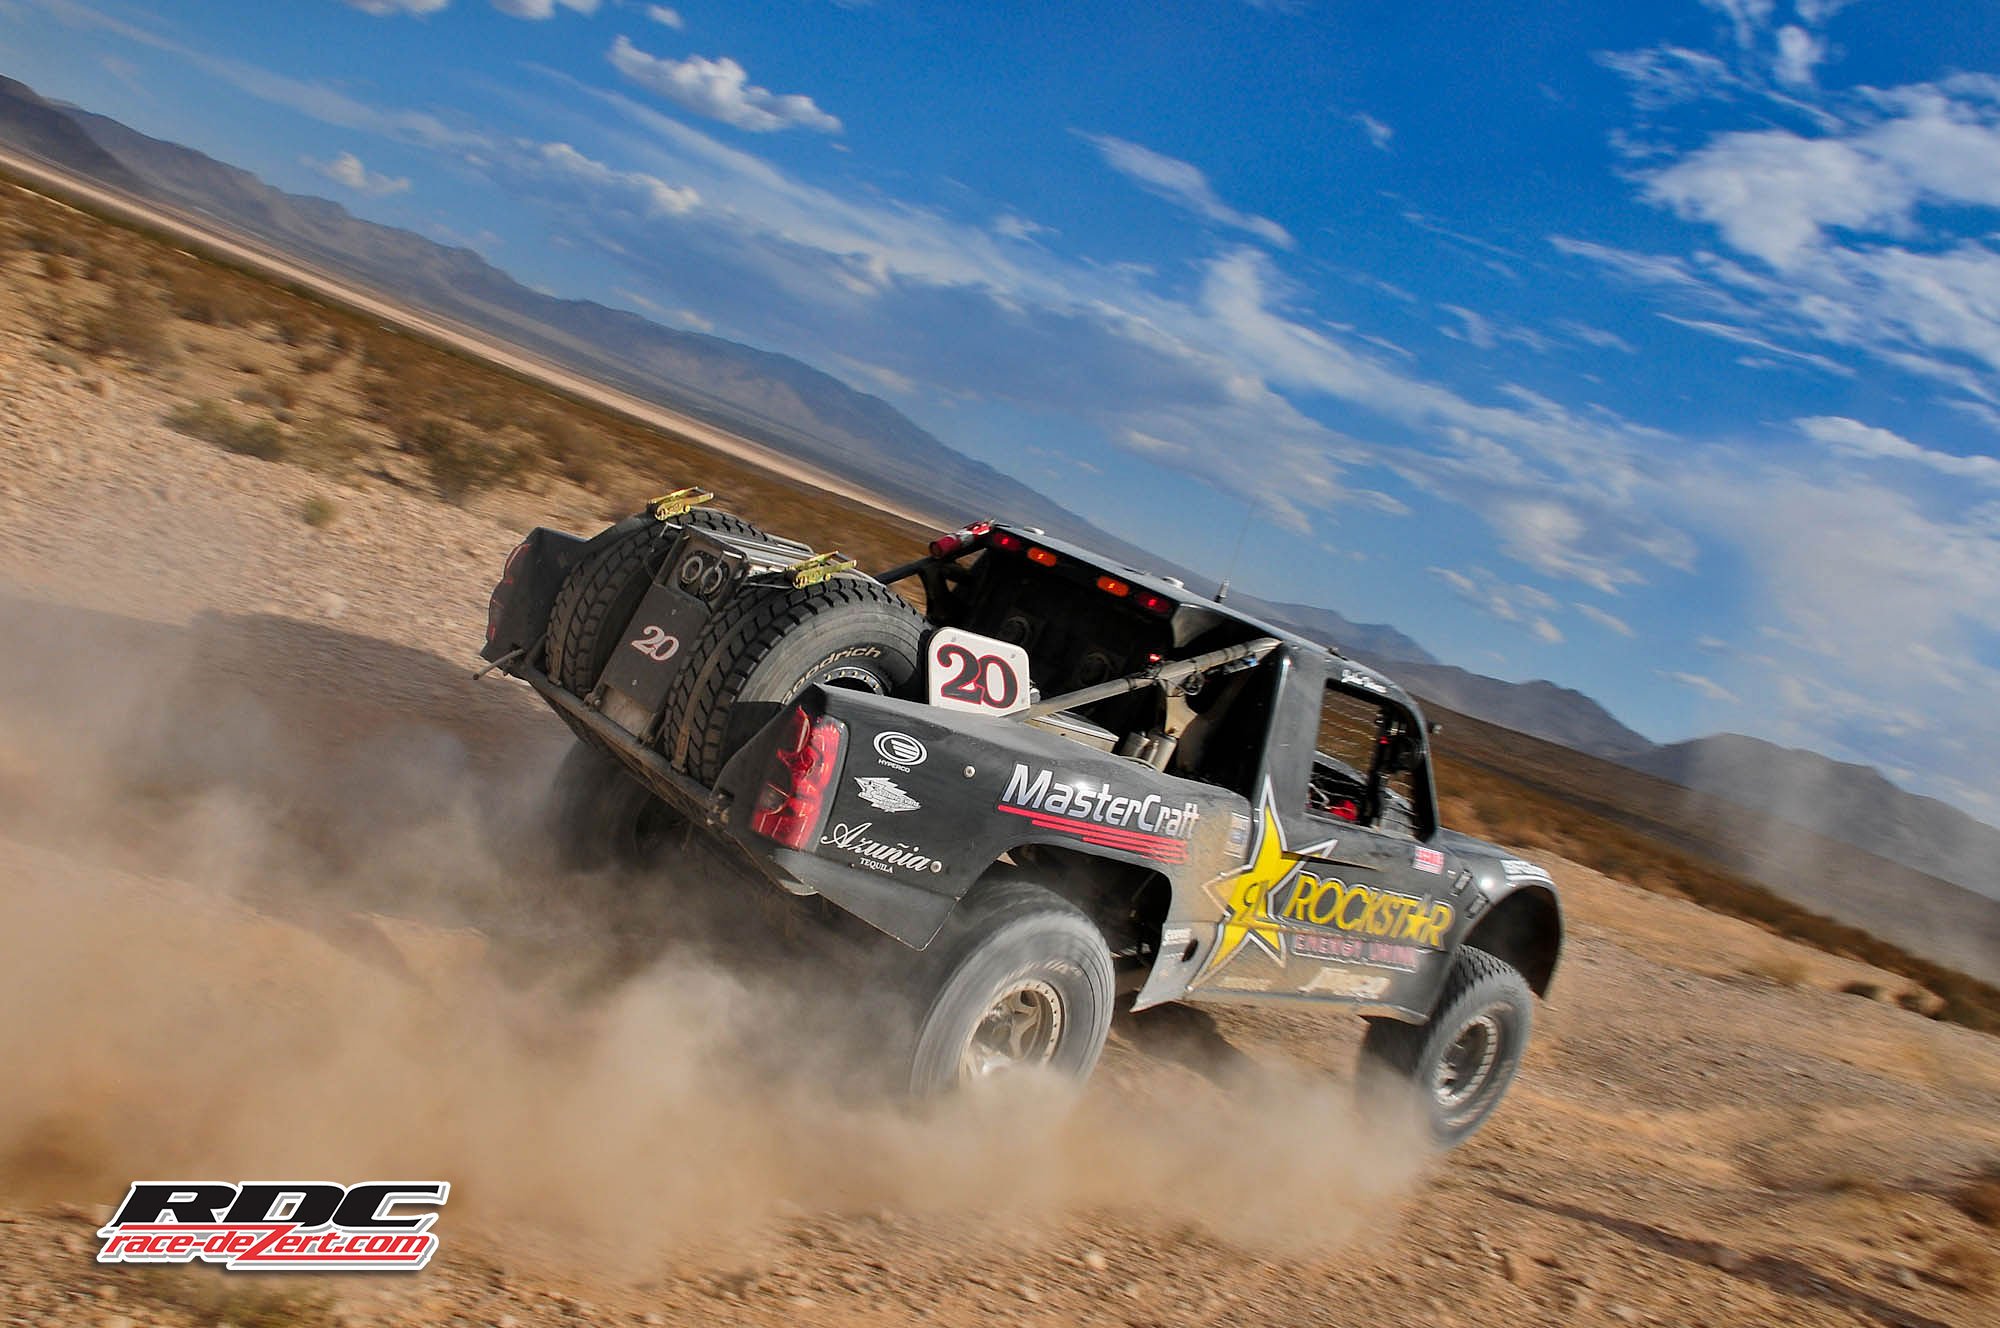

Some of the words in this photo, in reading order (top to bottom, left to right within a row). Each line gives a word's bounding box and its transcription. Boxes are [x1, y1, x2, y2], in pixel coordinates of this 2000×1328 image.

[631, 625, 680, 662] 20
[936, 643, 1018, 709] 20
[878, 758, 911, 774] HYPERCO
[1001, 763, 1200, 840] MasterCraft
[820, 822, 931, 872] Azuñia
[860, 857, 894, 874] TEQUILA
